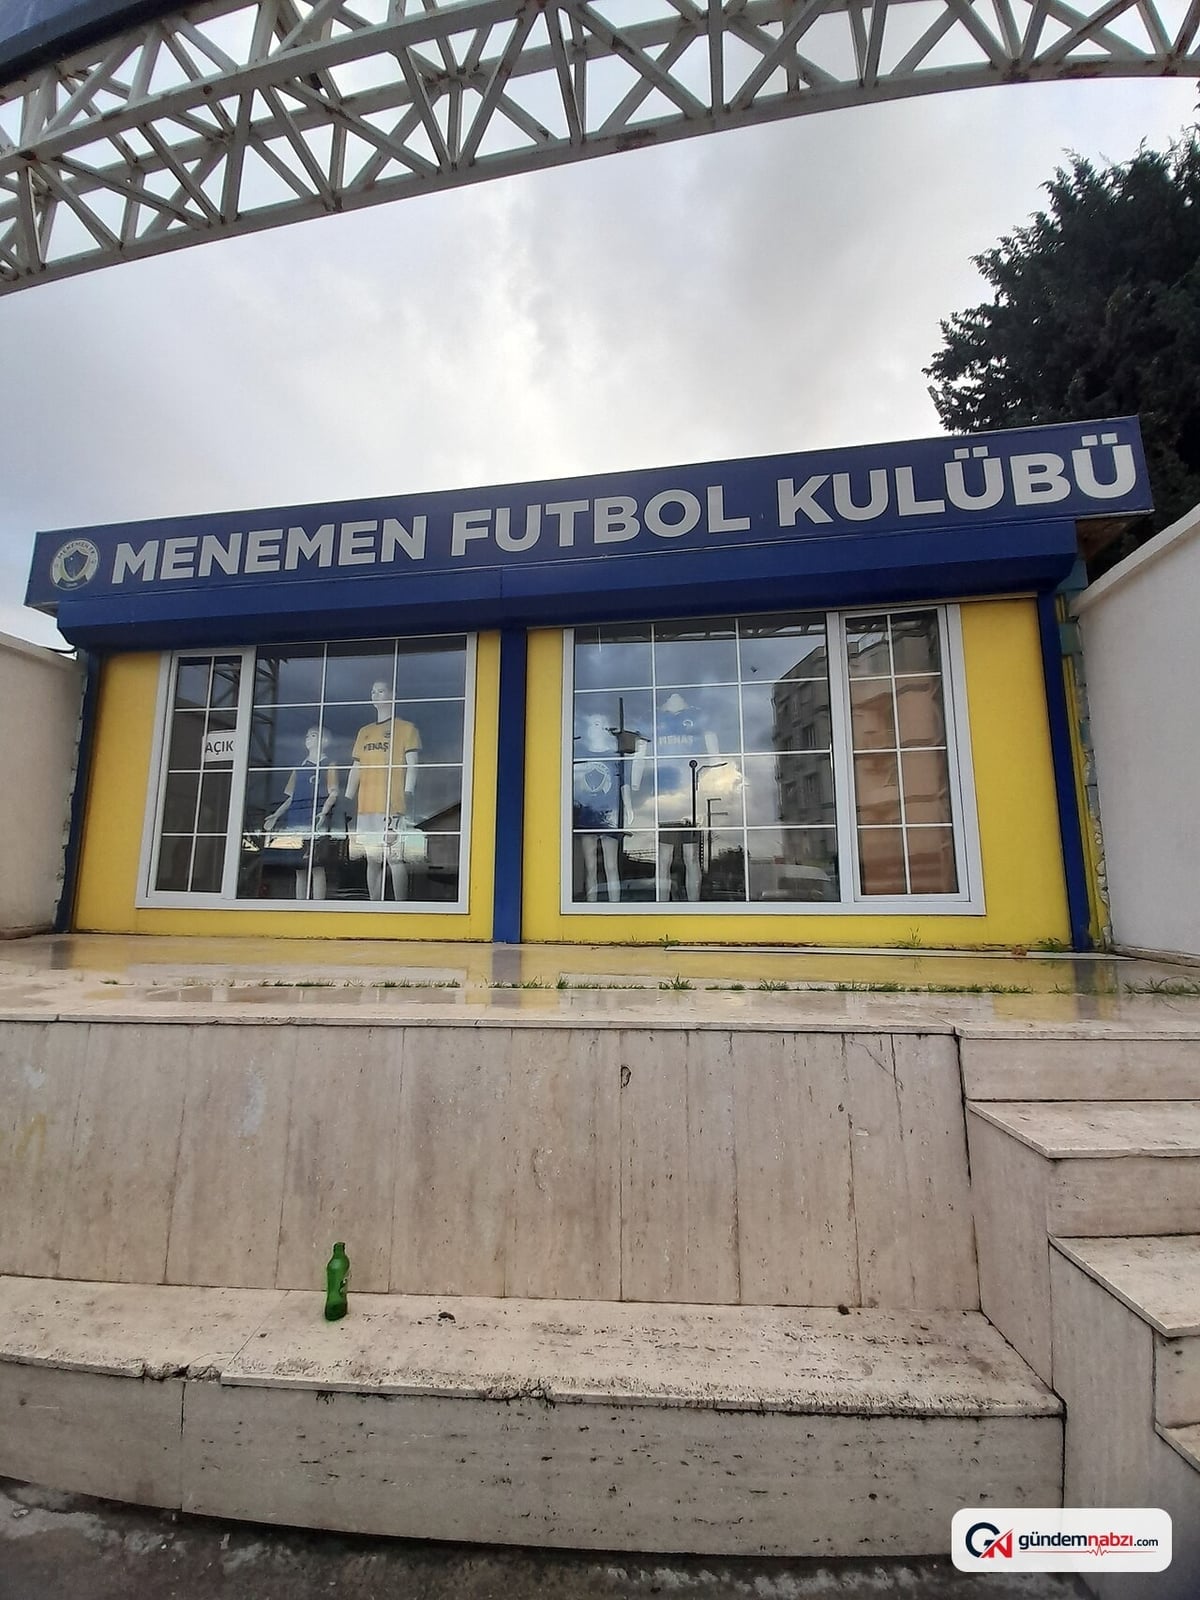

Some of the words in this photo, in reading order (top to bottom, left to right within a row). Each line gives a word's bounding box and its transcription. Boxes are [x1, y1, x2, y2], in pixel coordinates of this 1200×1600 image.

[111, 515, 427, 584] MENEMEN
[450, 485, 751, 557] FUTBOL
[776, 432, 1136, 527] KULÜBÜ
[205, 740, 234, 755] AÇIK
